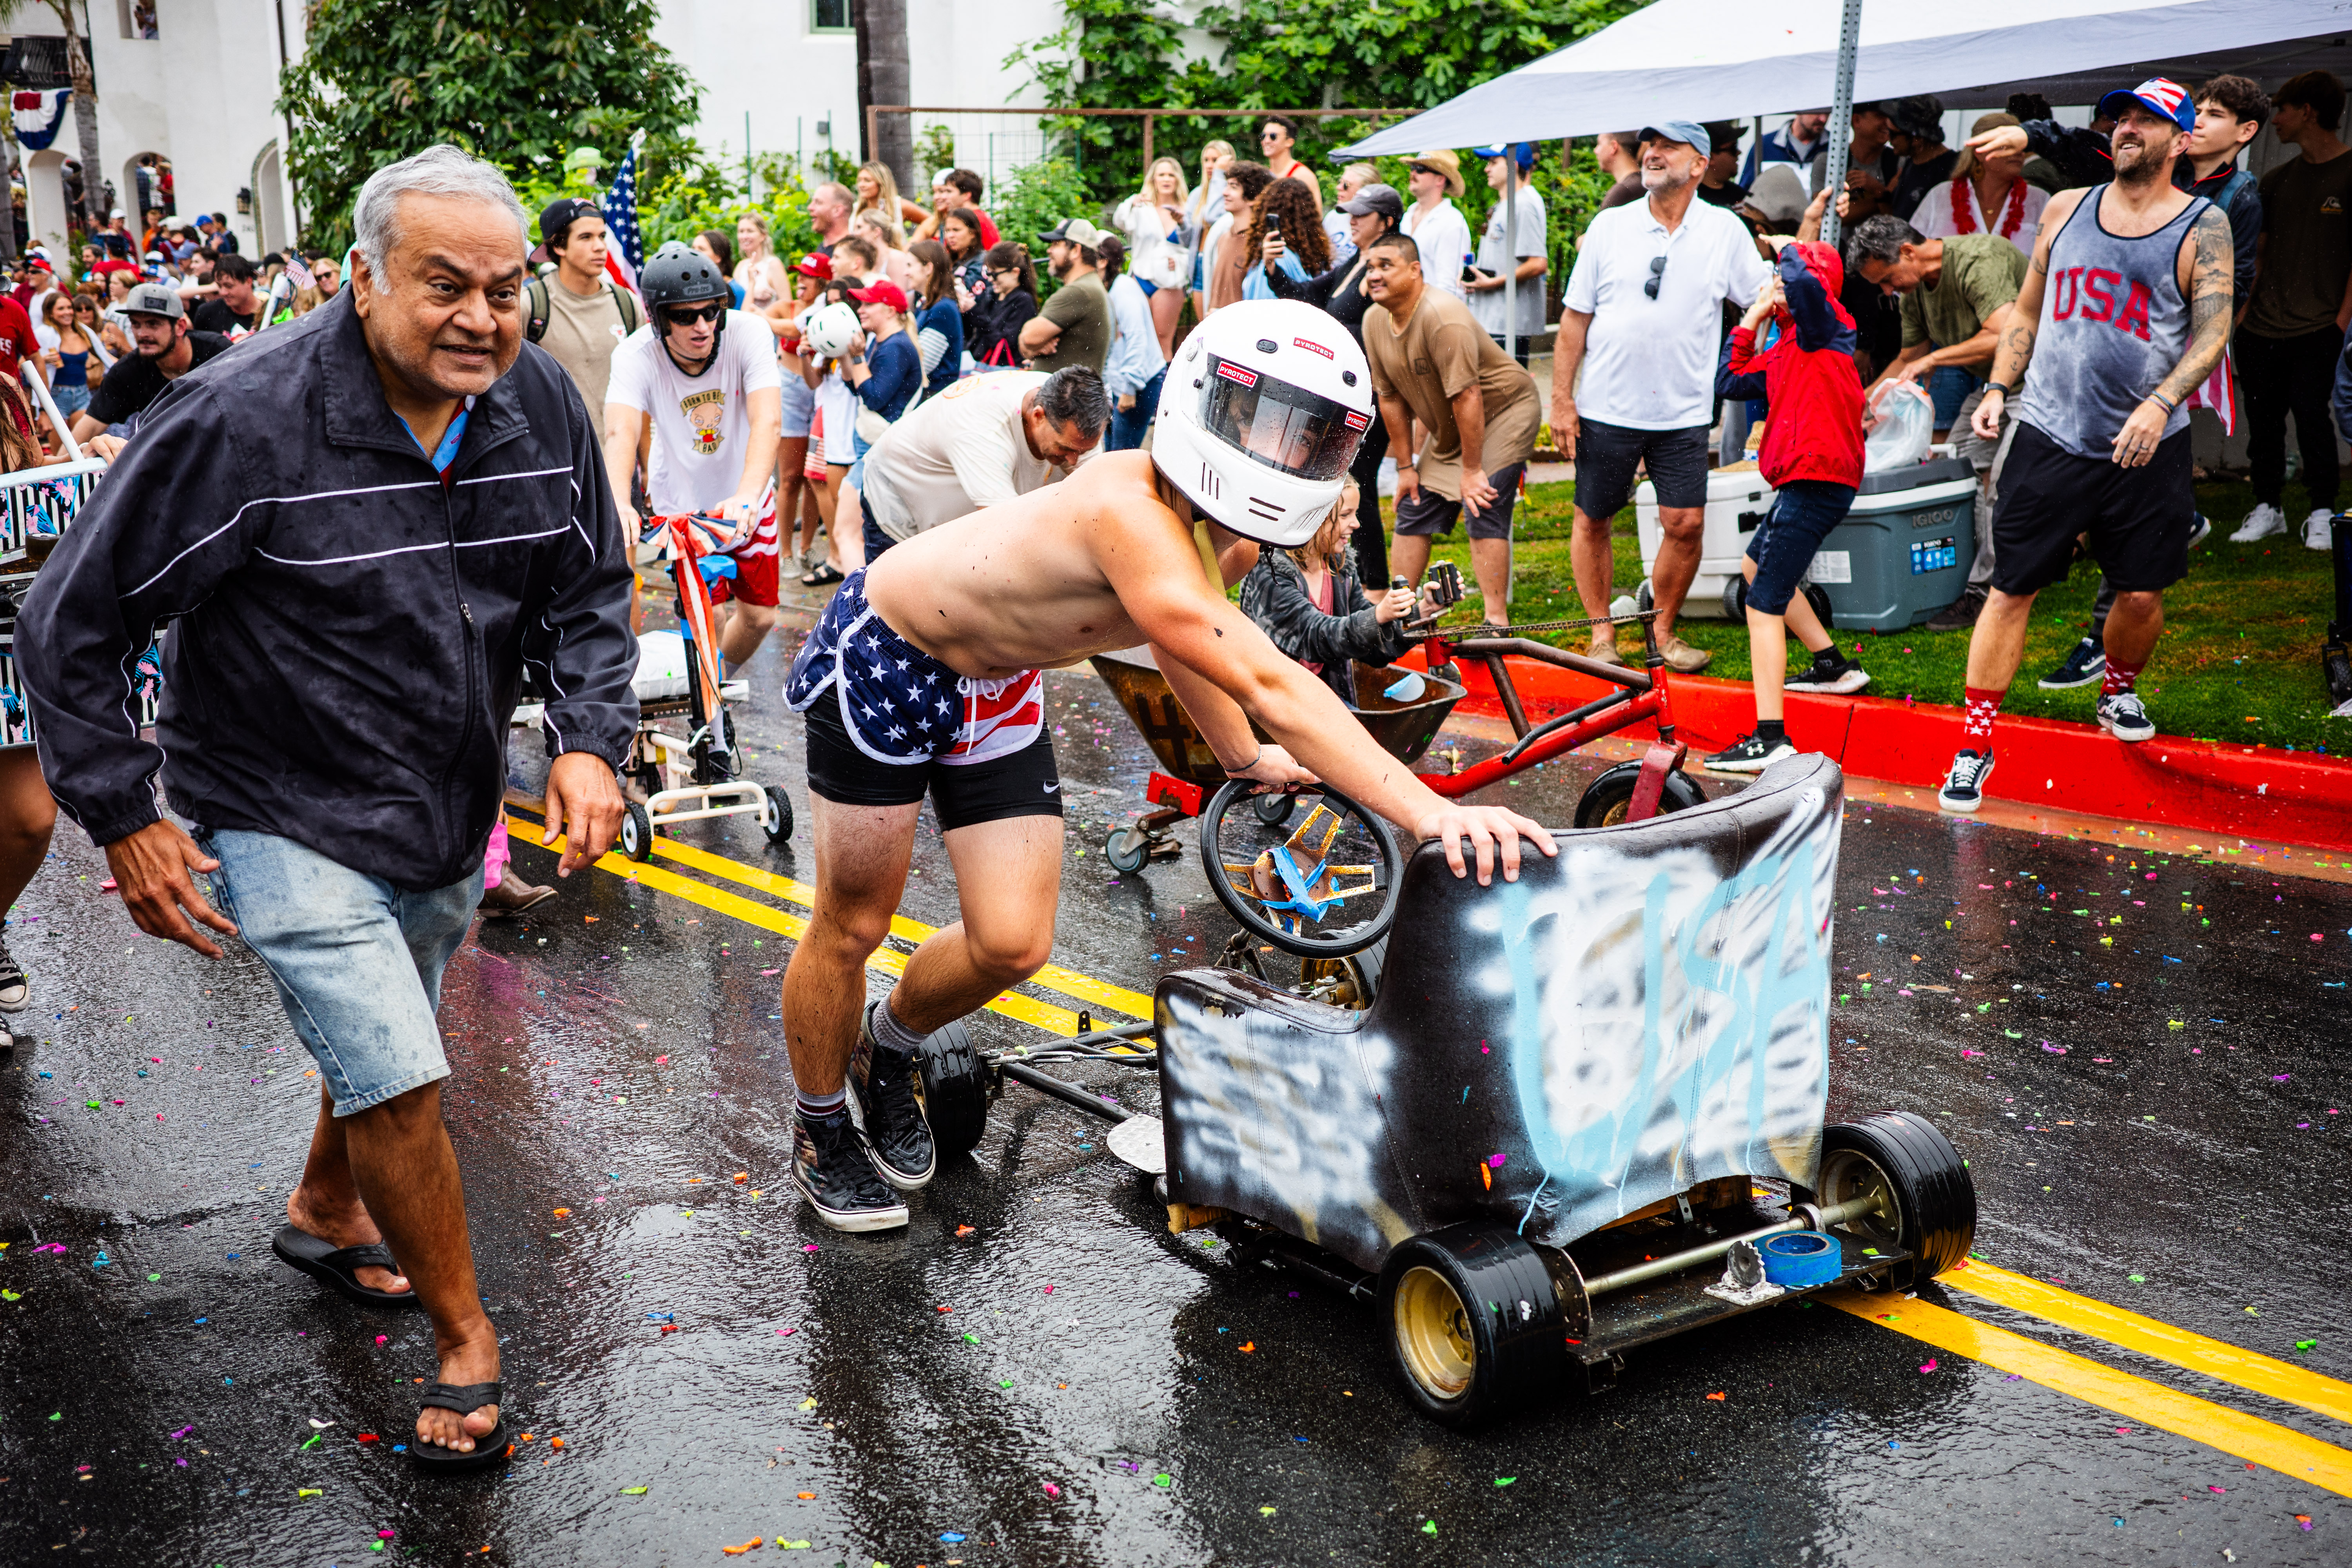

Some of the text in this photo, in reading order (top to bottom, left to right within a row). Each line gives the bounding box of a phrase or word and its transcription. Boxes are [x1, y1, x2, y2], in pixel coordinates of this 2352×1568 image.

[2053, 266, 2152, 342] USA
[1295, 339, 1333, 358] PYROTECT
[1220, 366, 1254, 383] PYROTECT
[683, 396, 701, 408] BORN
[702, 393, 711, 401] TO
[703, 442, 717, 452] BAD
[1913, 510, 1953, 527] IGLOO
[1501, 840, 1829, 1182] USA
